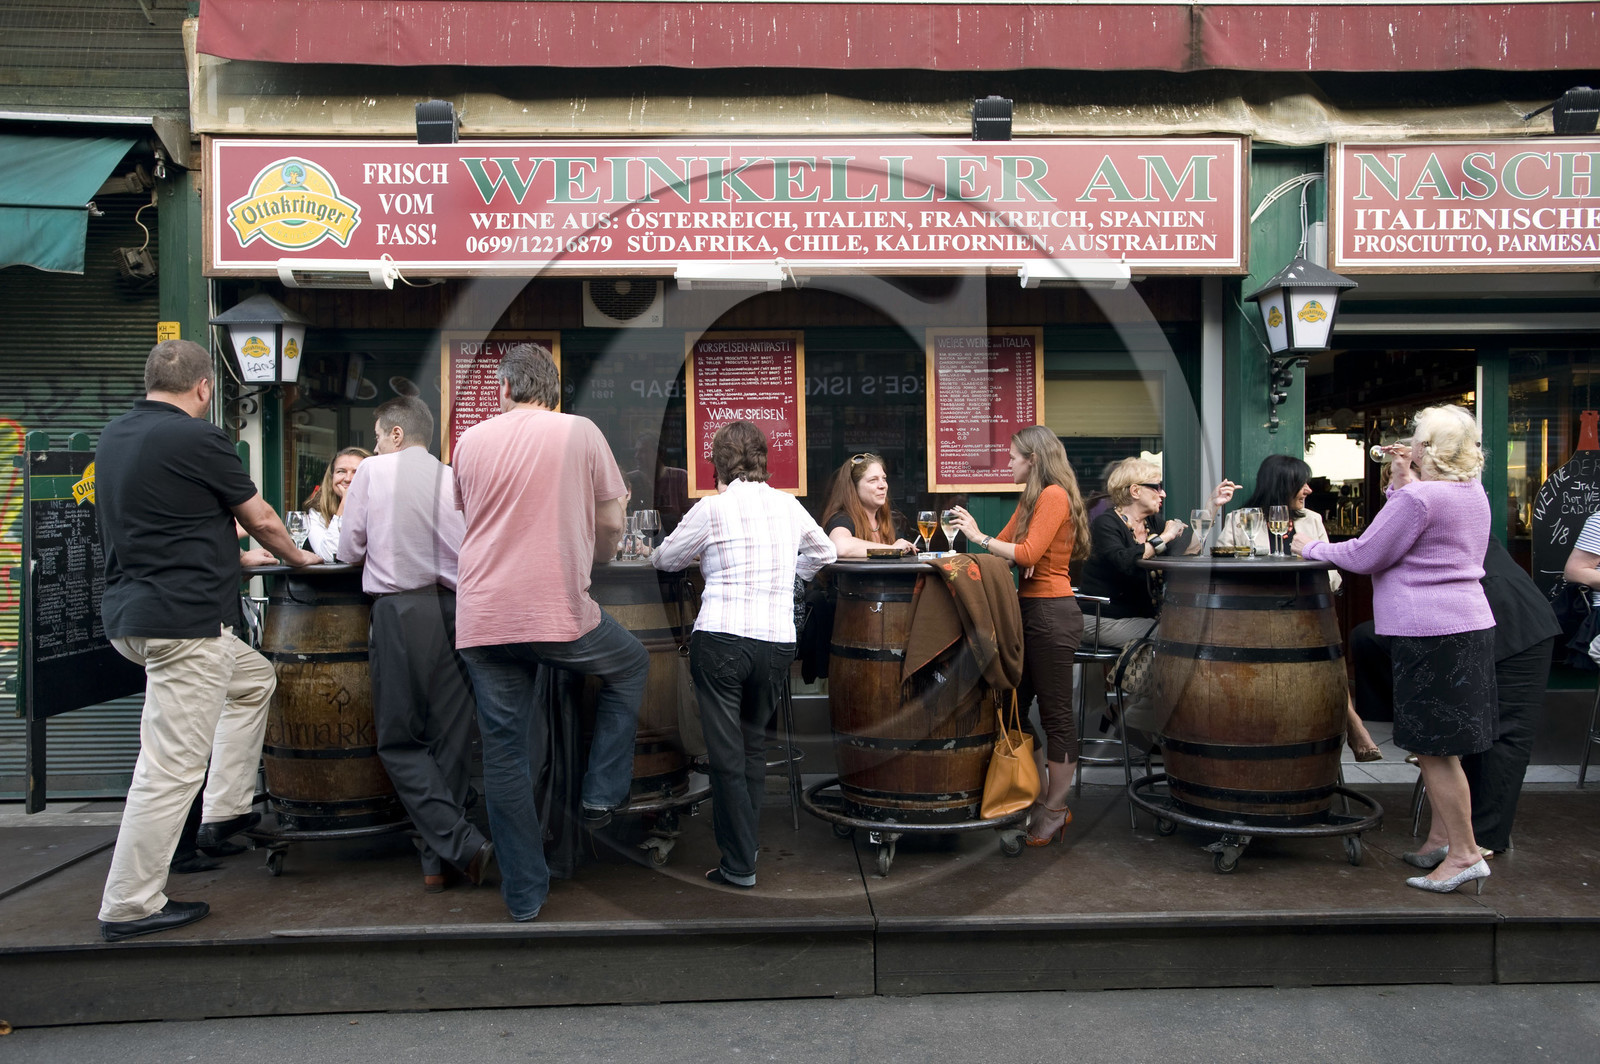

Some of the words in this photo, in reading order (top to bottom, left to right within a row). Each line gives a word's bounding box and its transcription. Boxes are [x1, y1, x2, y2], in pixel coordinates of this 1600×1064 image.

[363, 163, 449, 184] FRISCH
[459, 155, 1057, 204] WEINKELLER
[1076, 155, 1217, 202] AM
[1353, 151, 1600, 201] NASCH
[241, 195, 346, 225] Ottakringer
[378, 193, 434, 215] VOM
[470, 212, 555, 229] WEINE
[562, 212, 619, 229] AUS:
[626, 208, 798, 231] ÖSTERREICH,
[804, 211, 913, 231] ITALIEN,
[920, 210, 1093, 231] FRANKREICH,
[1100, 210, 1205, 228] SPANIEN
[376, 223, 437, 245] FASS!
[466, 236, 613, 253] 0699/12216879
[628, 231, 778, 255] SÜDAFRIKA,
[784, 235, 869, 255] CHILE,
[875, 234, 1054, 254] KALIFORNIEN,
[1061, 234, 1217, 251] AUSTRALIEN
[1353, 234, 1492, 255] PROSCIUTTO,
[1497, 234, 1600, 252] PARMESA
[460, 342, 493, 355] ROTE
[698, 341, 790, 353] VORSPEISEN-ANTIPASTI
[966, 337, 991, 348] WEINE
[1002, 337, 1031, 348] ITALIA
[706, 407, 744, 420] WARME
[37, 500, 64, 509] WINE
[1534, 466, 1570, 521] WEINE
[65, 536, 91, 545] WEINE
[1549, 517, 1570, 545] 1/8
